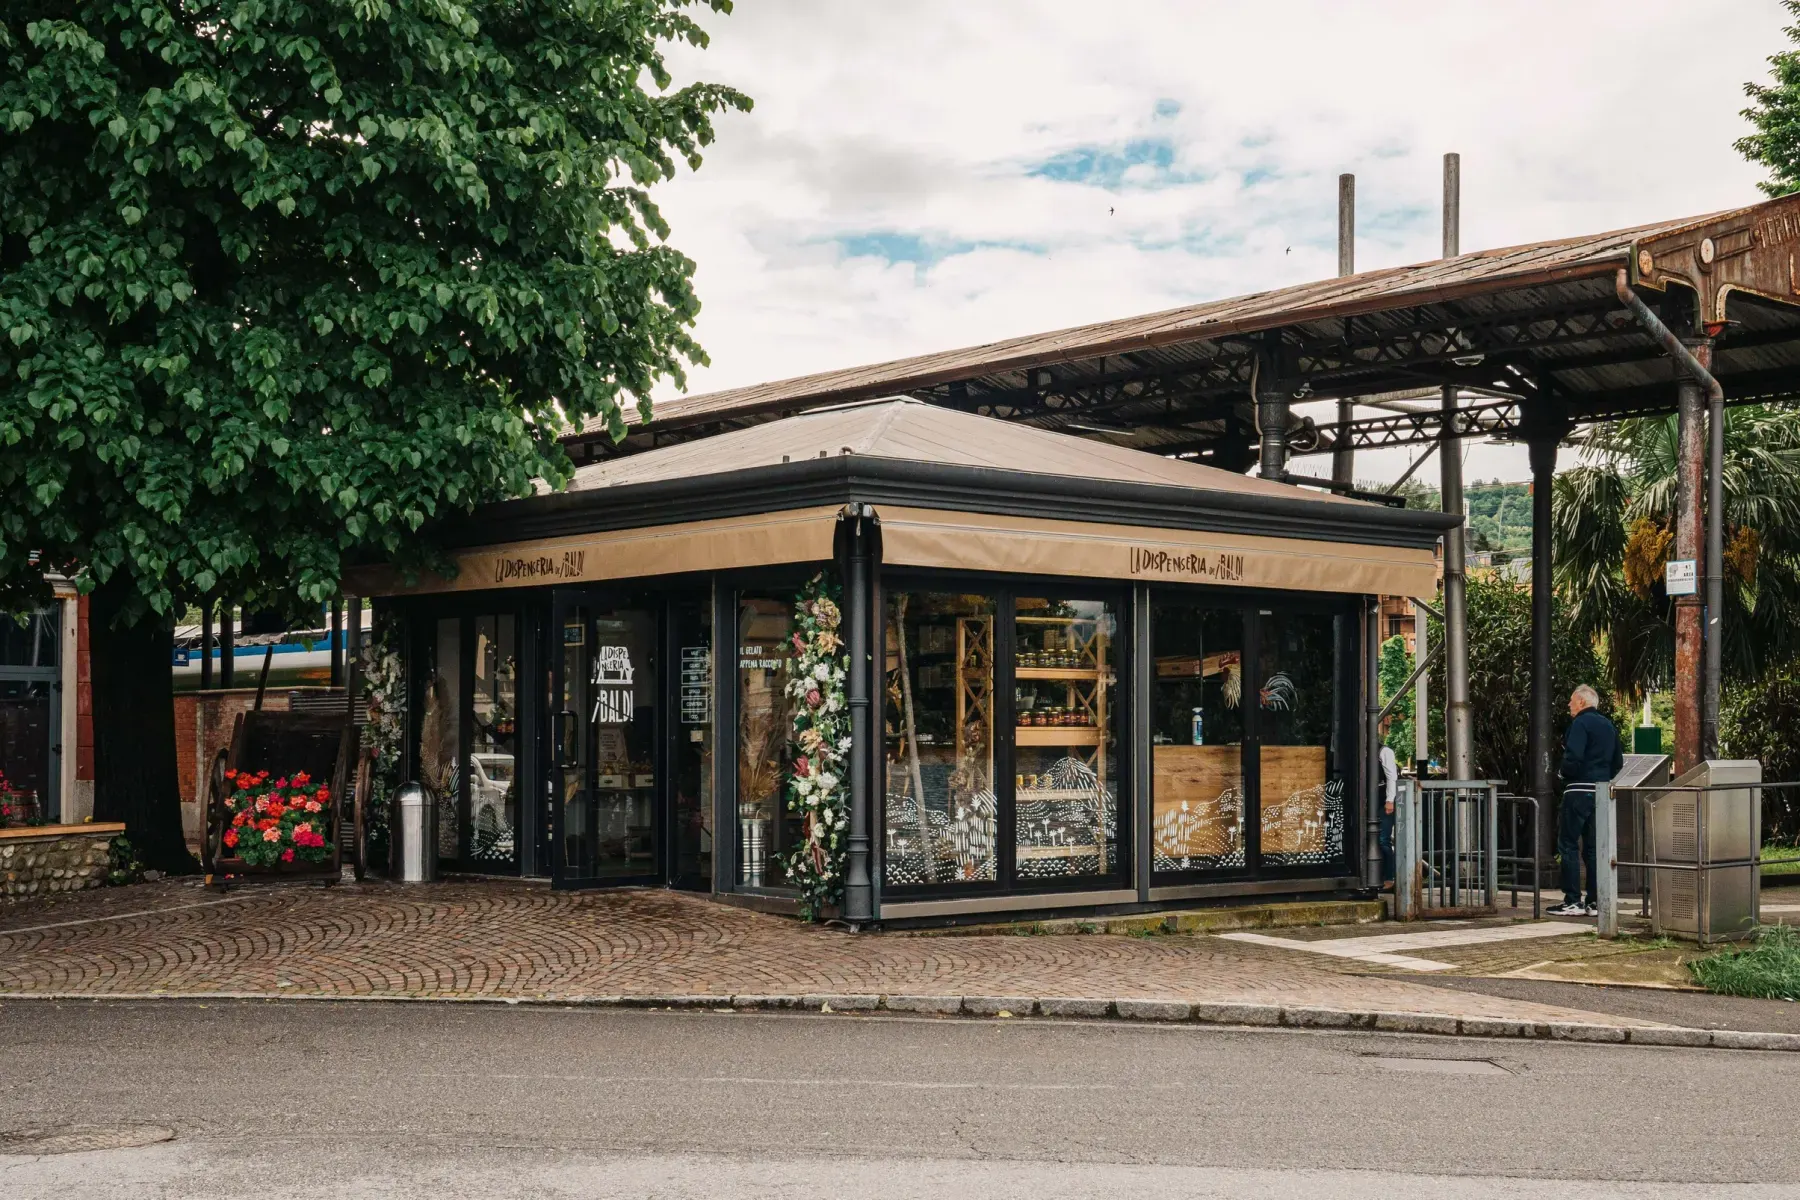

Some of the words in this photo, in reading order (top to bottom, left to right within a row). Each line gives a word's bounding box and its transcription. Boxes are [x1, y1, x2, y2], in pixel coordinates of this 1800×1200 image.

[504, 557, 554, 580] DISPENSERIA
[1130, 547, 1141, 574] LA
[1142, 549, 1206, 574] DISPENSERIA
[745, 646, 763, 655] GELATO
[740, 659, 758, 669] APPENA
